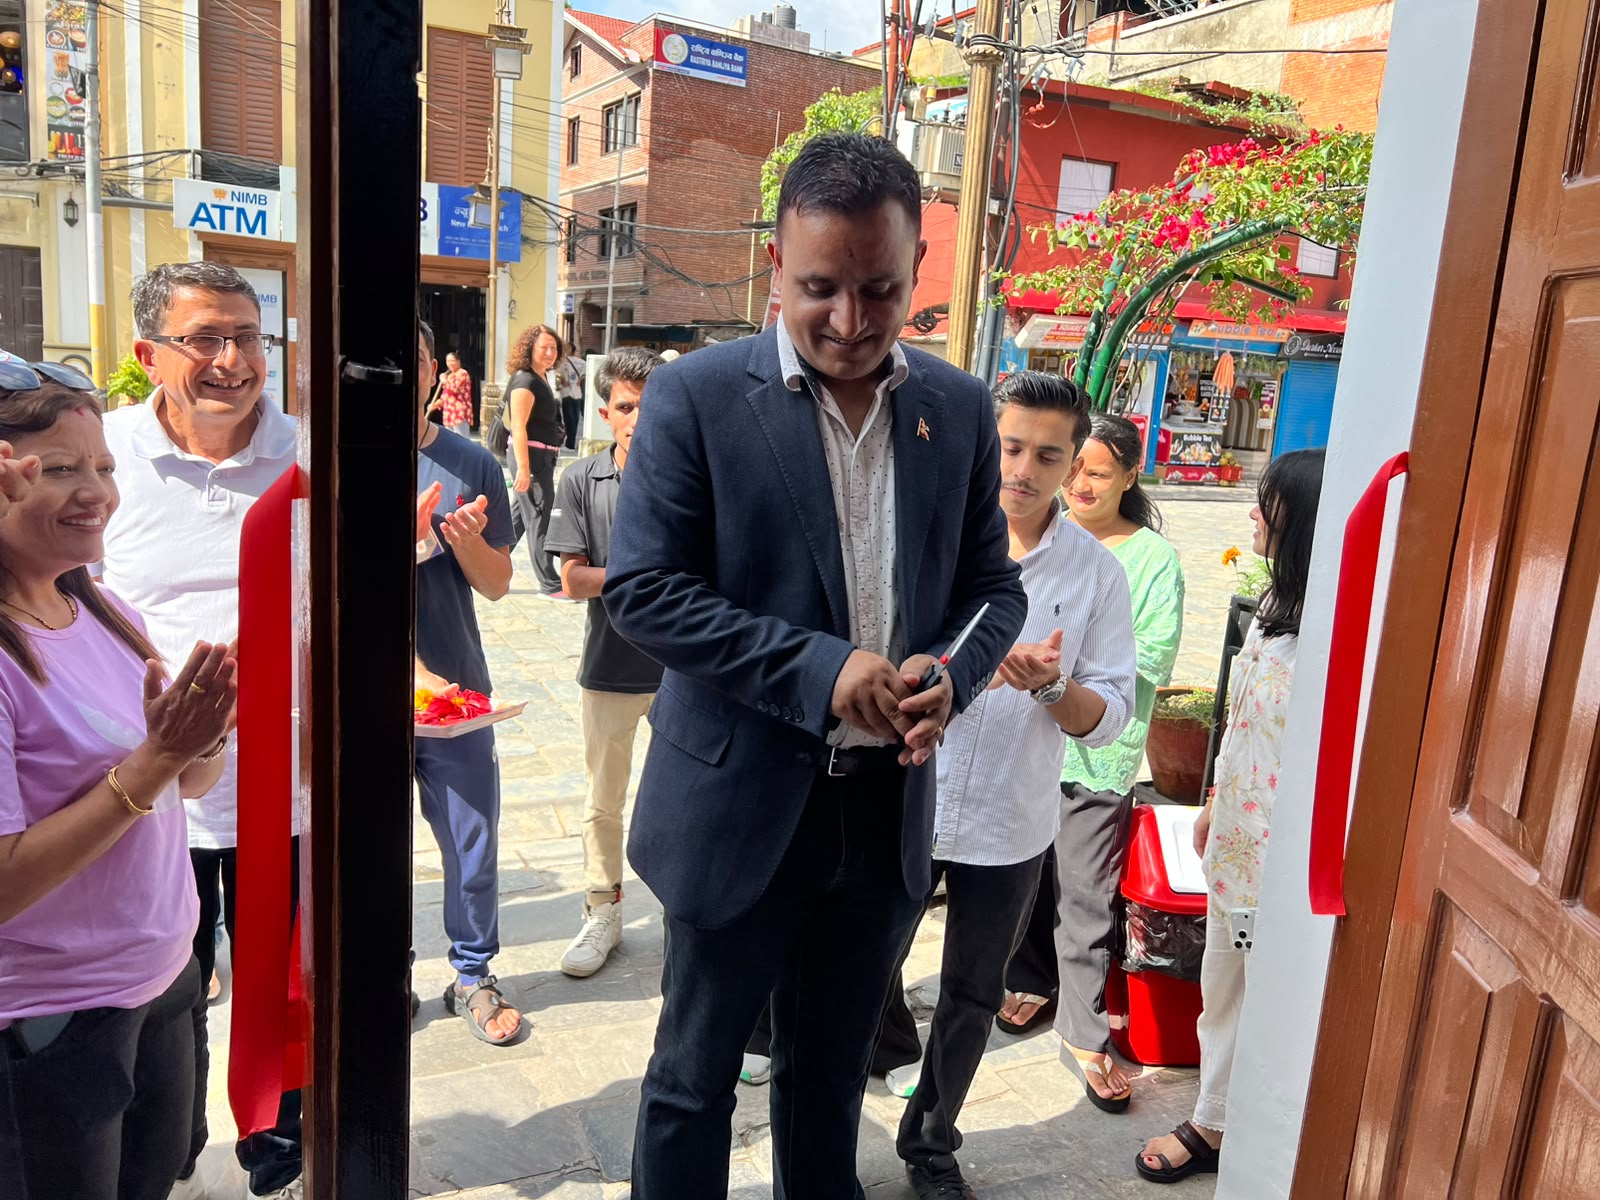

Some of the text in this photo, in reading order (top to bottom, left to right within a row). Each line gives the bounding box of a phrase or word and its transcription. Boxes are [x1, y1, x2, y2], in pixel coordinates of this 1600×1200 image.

[731, 64, 743, 74] BANK
[230, 190, 268, 206] NIMB
[188, 202, 267, 236] ATM
[450, 219, 466, 228] New
[1256, 325, 1275, 336] Tea
[1183, 433, 1212, 442] Bubble Tea
